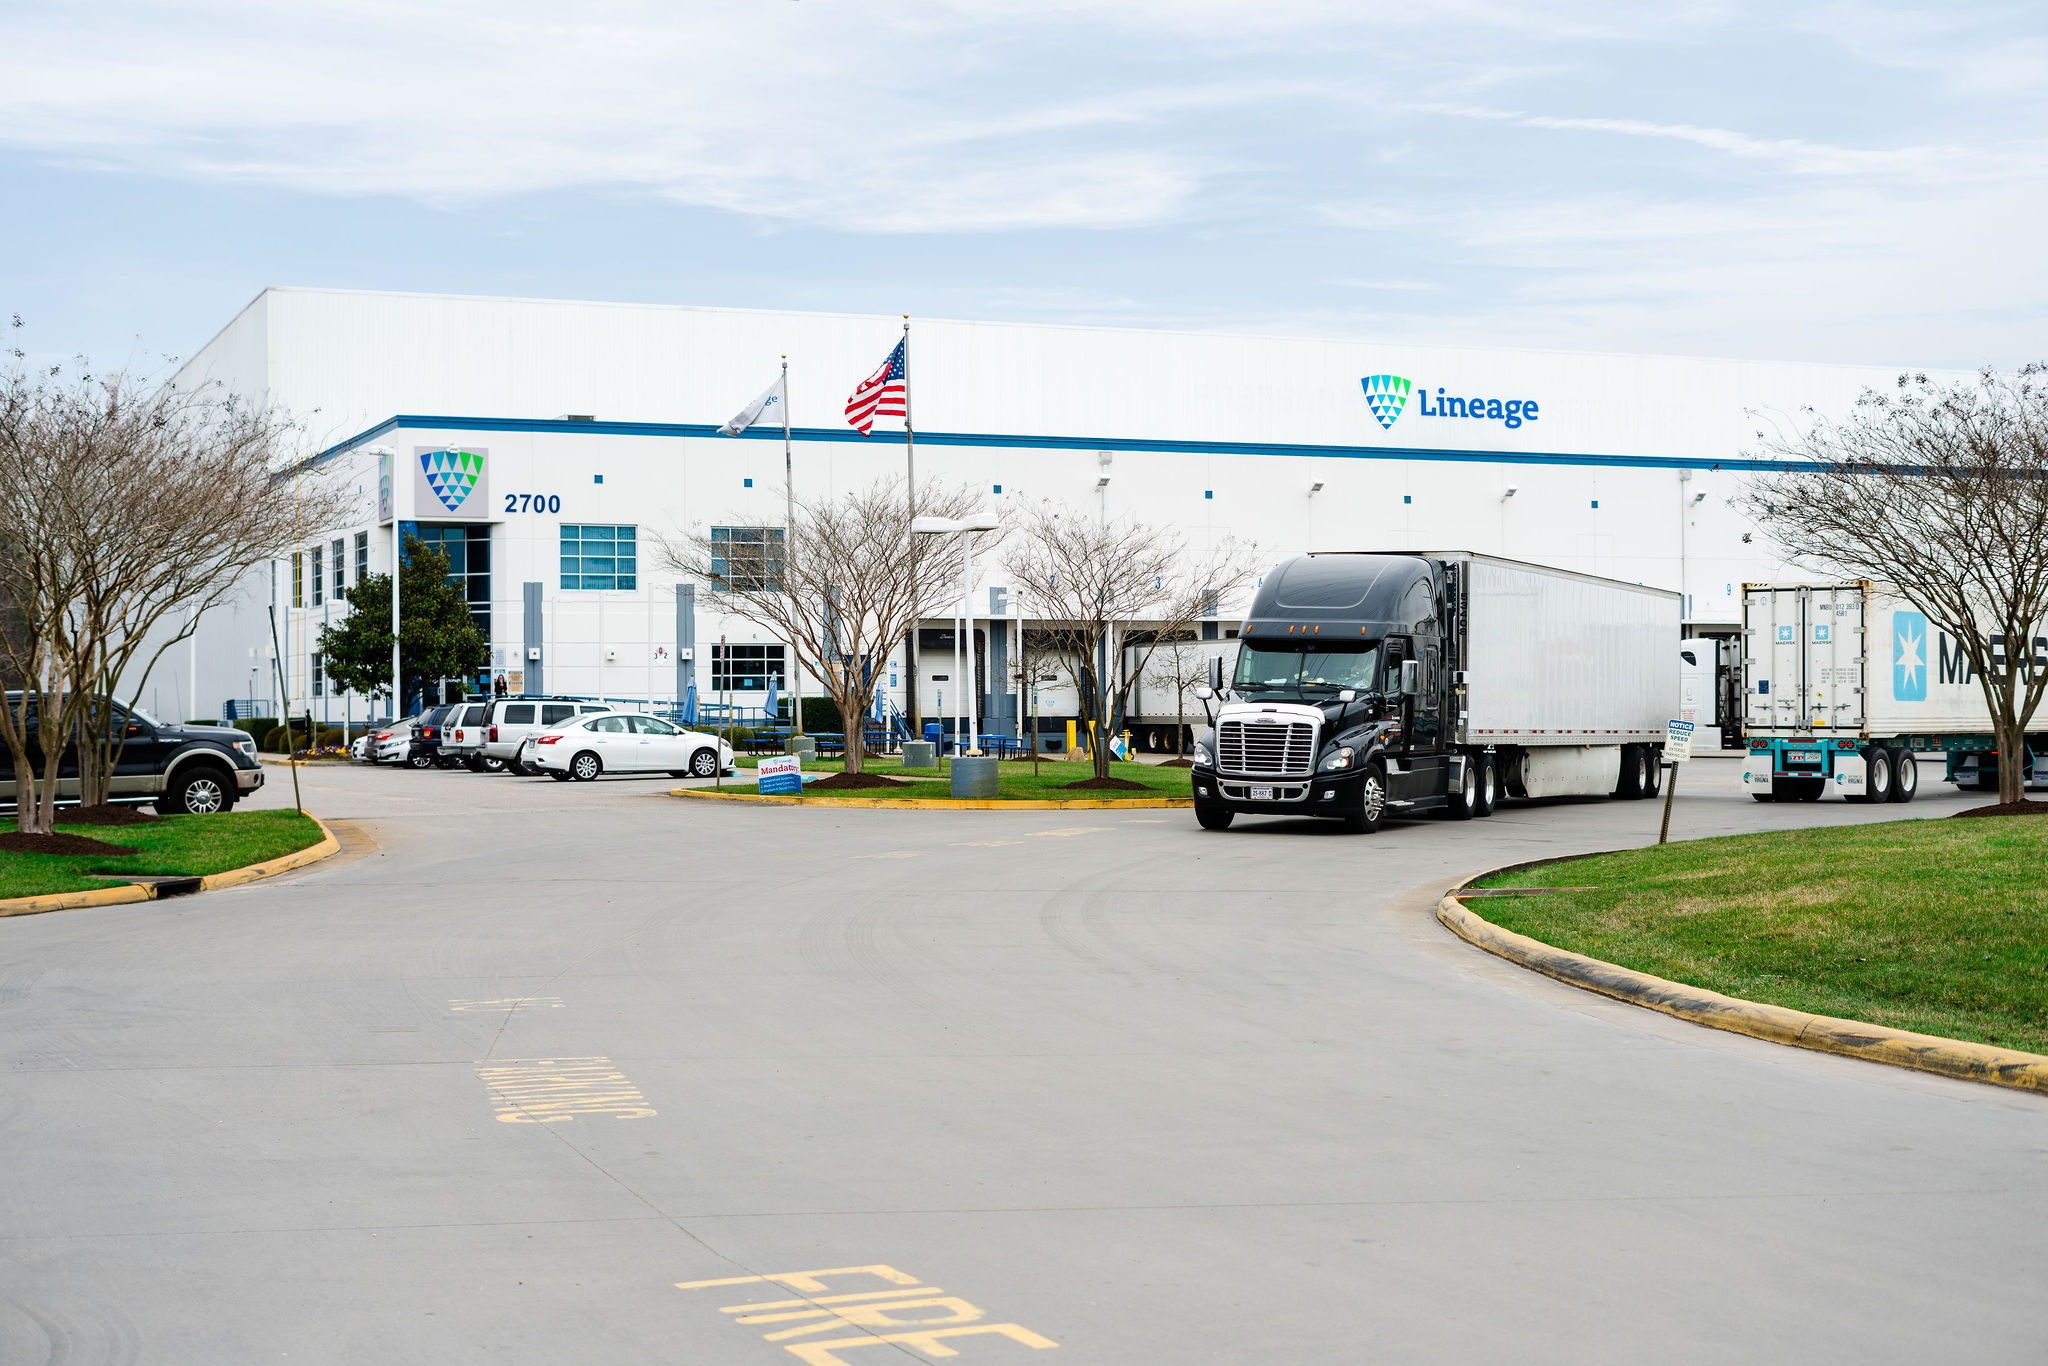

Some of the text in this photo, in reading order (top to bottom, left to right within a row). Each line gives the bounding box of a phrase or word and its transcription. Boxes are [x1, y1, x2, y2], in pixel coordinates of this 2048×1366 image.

[1418, 387, 1539, 429] Lineage
[505, 494, 561, 513] 2700
[1669, 729, 1691, 737] REDUCE
[1670, 721, 1693, 730] NOTICE
[674, 1264, 1060, 1366] FIRE
